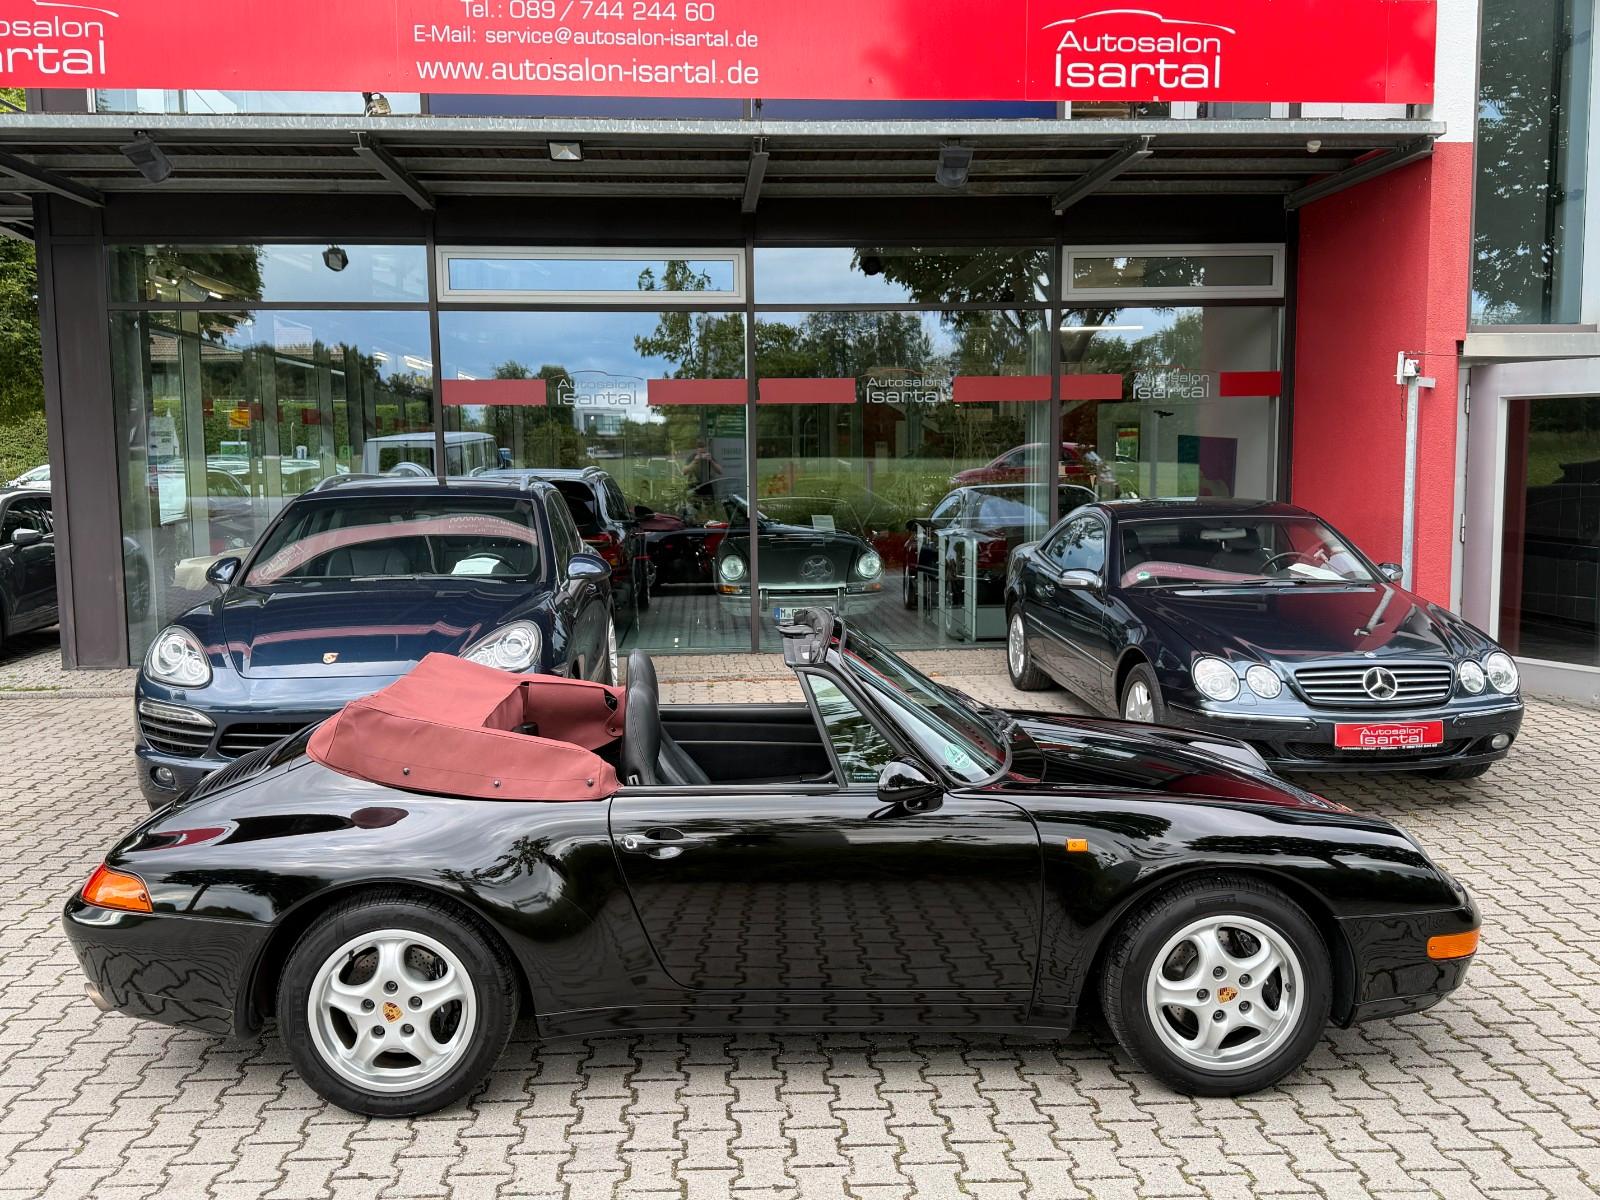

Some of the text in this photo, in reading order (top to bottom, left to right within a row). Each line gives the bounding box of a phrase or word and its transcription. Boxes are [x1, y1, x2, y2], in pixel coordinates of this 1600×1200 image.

[461, 0, 502, 18] Tel.:
[509, 0, 555, 19] 089
[580, 1, 624, 20] 744
[633, 2, 677, 21] 244
[685, 3, 715, 22] 60
[413, 24, 758, 48] E-Mail: service@autosalon-isartal.de
[1056, 30, 1221, 54] Autosalon
[0, 39, 106, 75] rtal
[416, 57, 759, 85] www.autosalon-isartal.de
[1055, 53, 1221, 89] Isartal
[867, 377, 944, 388] Autosalon
[1133, 372, 1210, 383] Aosalon
[557, 388, 637, 405] Isartal
[866, 387, 943, 404] Isartal
[1132, 382, 1210, 400] Isartal
[1360, 730, 1423, 745] Isartal
[1361, 728, 1423, 736] Autosalon
